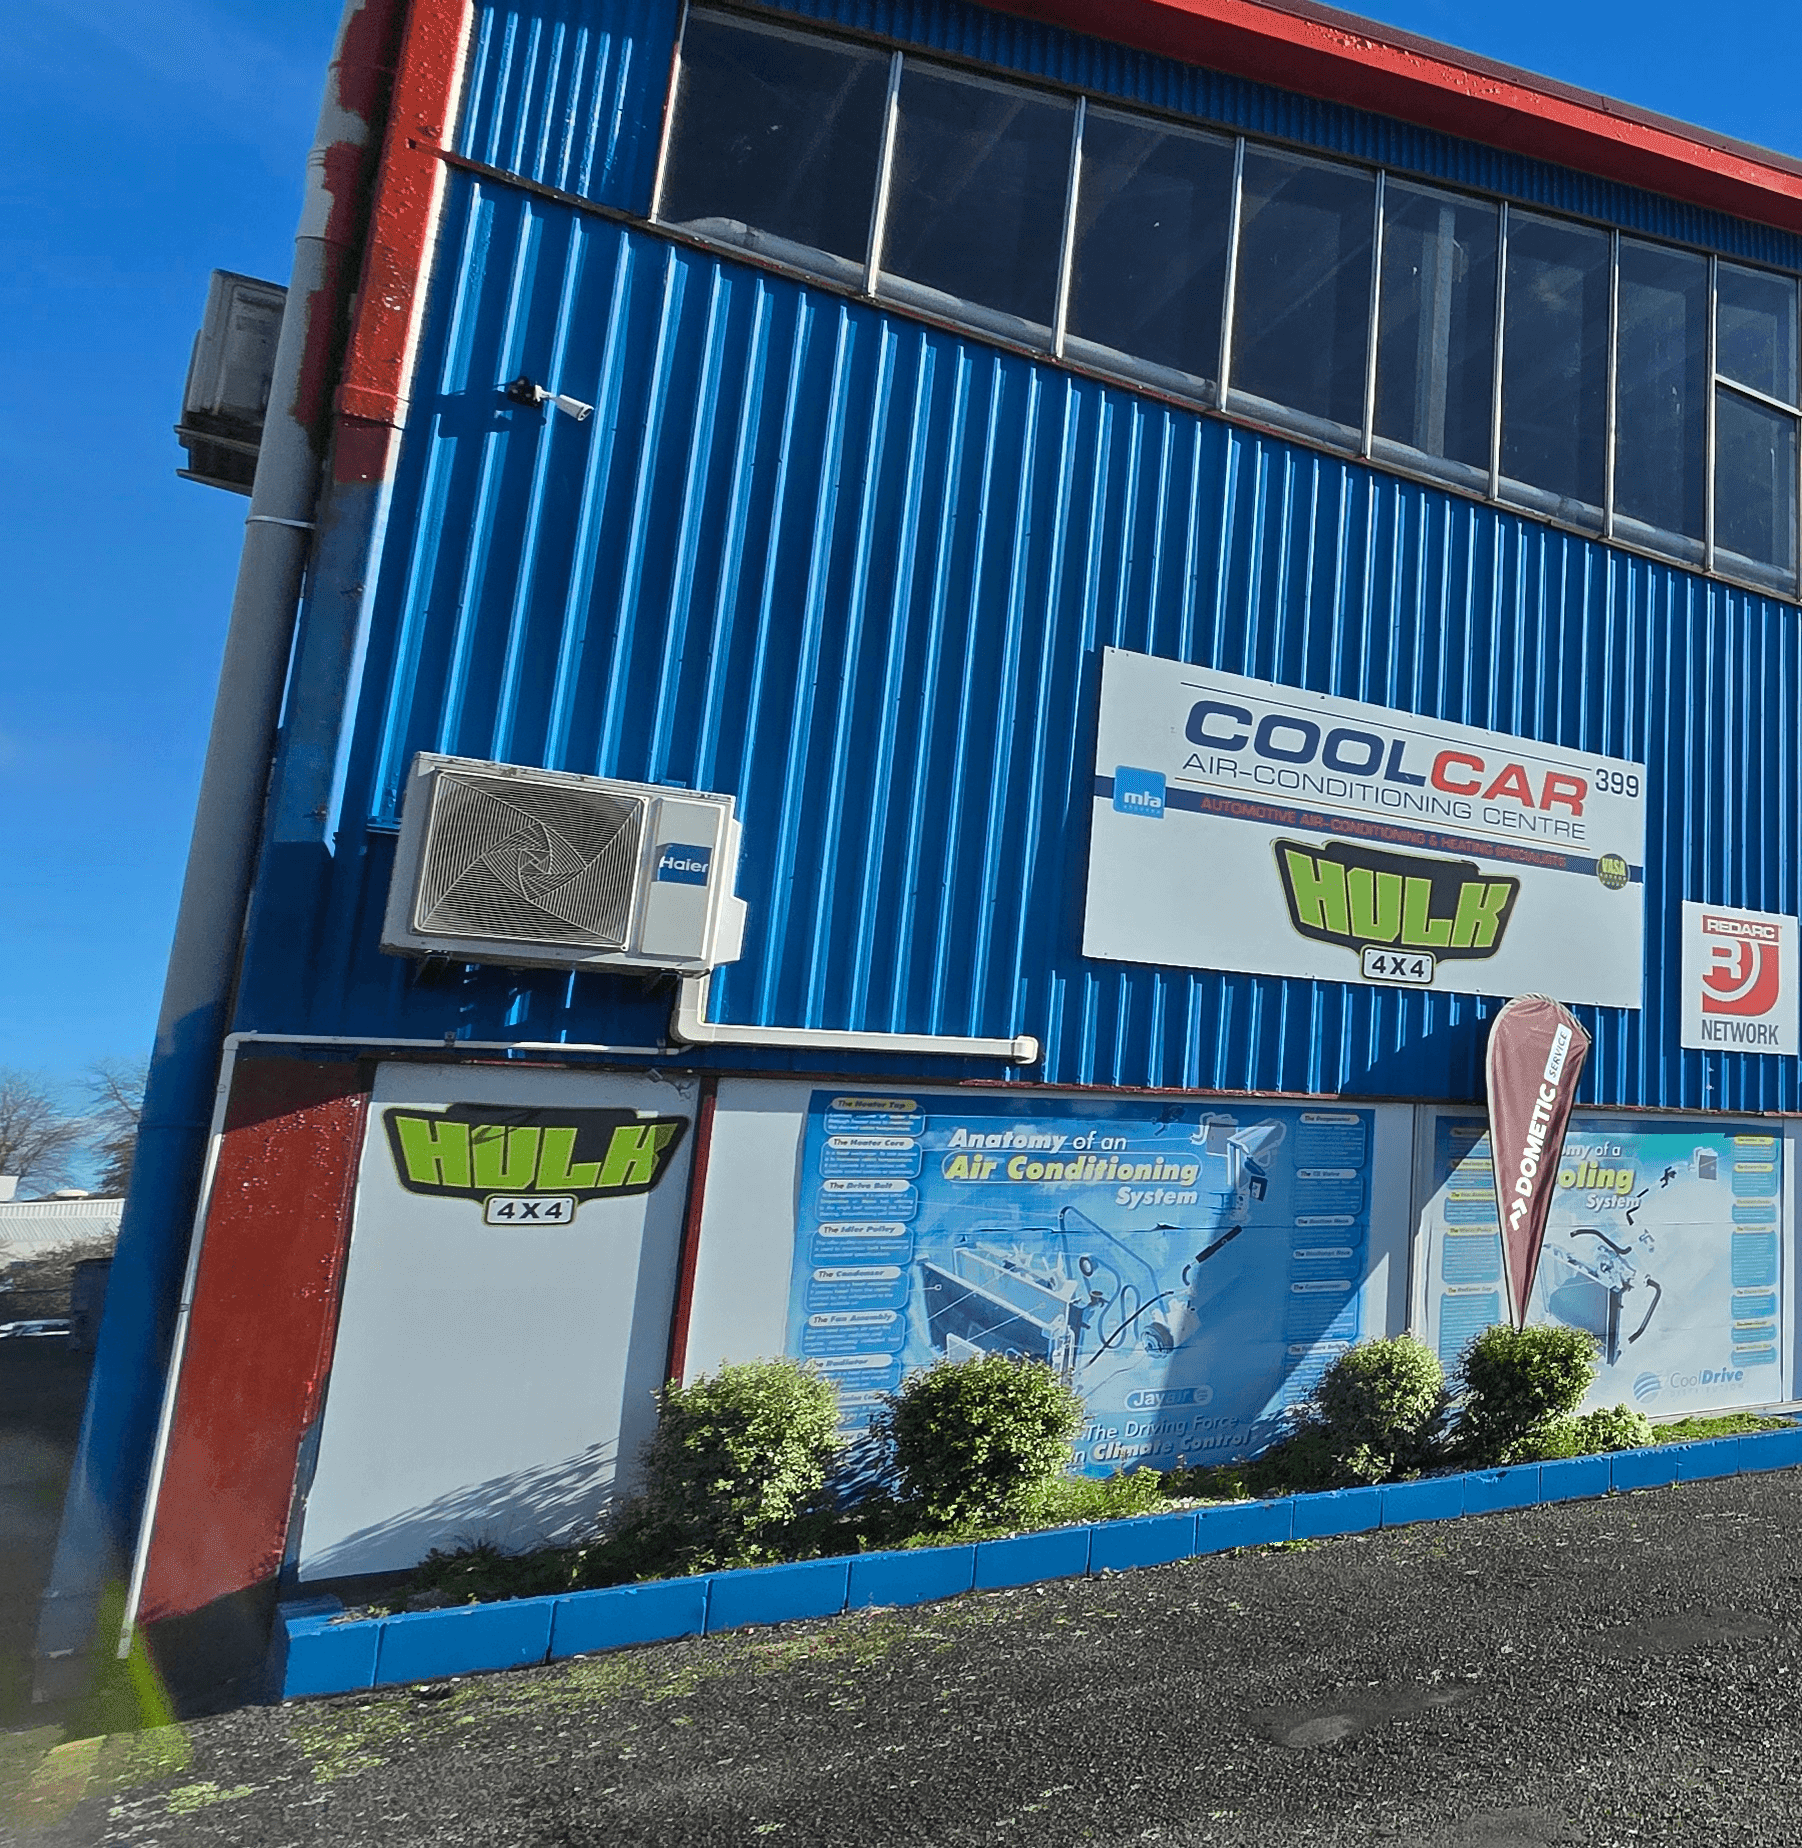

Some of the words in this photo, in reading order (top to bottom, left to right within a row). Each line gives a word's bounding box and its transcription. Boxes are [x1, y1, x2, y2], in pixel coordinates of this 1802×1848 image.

[1185, 699, 1588, 818] COOLCAR
[1182, 752, 1473, 820] AIR-CONDITIONING
[1483, 807, 1586, 840] CENTRE
[1595, 766, 1640, 799] 399
[1123, 791, 1162, 808] mta
[1200, 796, 1296, 825] AUTOMOTIVE
[1299, 813, 1425, 847] AIR-CONDITIONING
[1429, 834, 1438, 847] &
[1441, 837, 1493, 857] HEATING
[658, 855, 709, 873] Haier
[1285, 848, 1514, 949] HULK
[1706, 918, 1776, 940] REDARC
[1701, 1018, 1780, 1046] NETWORK
[1548, 1030, 1568, 1079] SERVICE
[394, 1115, 679, 1190] HULK
[948, 1128, 1069, 1154] Anatomy
[1072, 1130, 1097, 1150] of
[1100, 1136, 1127, 1150] an
[1514, 1082, 1557, 1198] DOMETIC
[1595, 1141, 1610, 1157] of
[1612, 1145, 1622, 1157] a
[944, 1154, 998, 1180] Air
[1007, 1154, 1200, 1187] Conditioning
[1558, 1160, 1636, 1197] oling
[496, 1201, 563, 1220] 4X4
[1116, 1186, 1199, 1209] System
[1586, 1193, 1642, 1213] System
[818, 1270, 833, 1278] The
[813, 1316, 828, 1324] The
[1670, 1366, 1744, 1389] CoolDrive
[1133, 1389, 1191, 1408] Jayair
[1085, 1424, 1119, 1442] The
[1124, 1418, 1188, 1439] Driving
[1193, 1414, 1239, 1430] Force
[1093, 1438, 1174, 1461] Climate
[1181, 1431, 1250, 1450] Control
